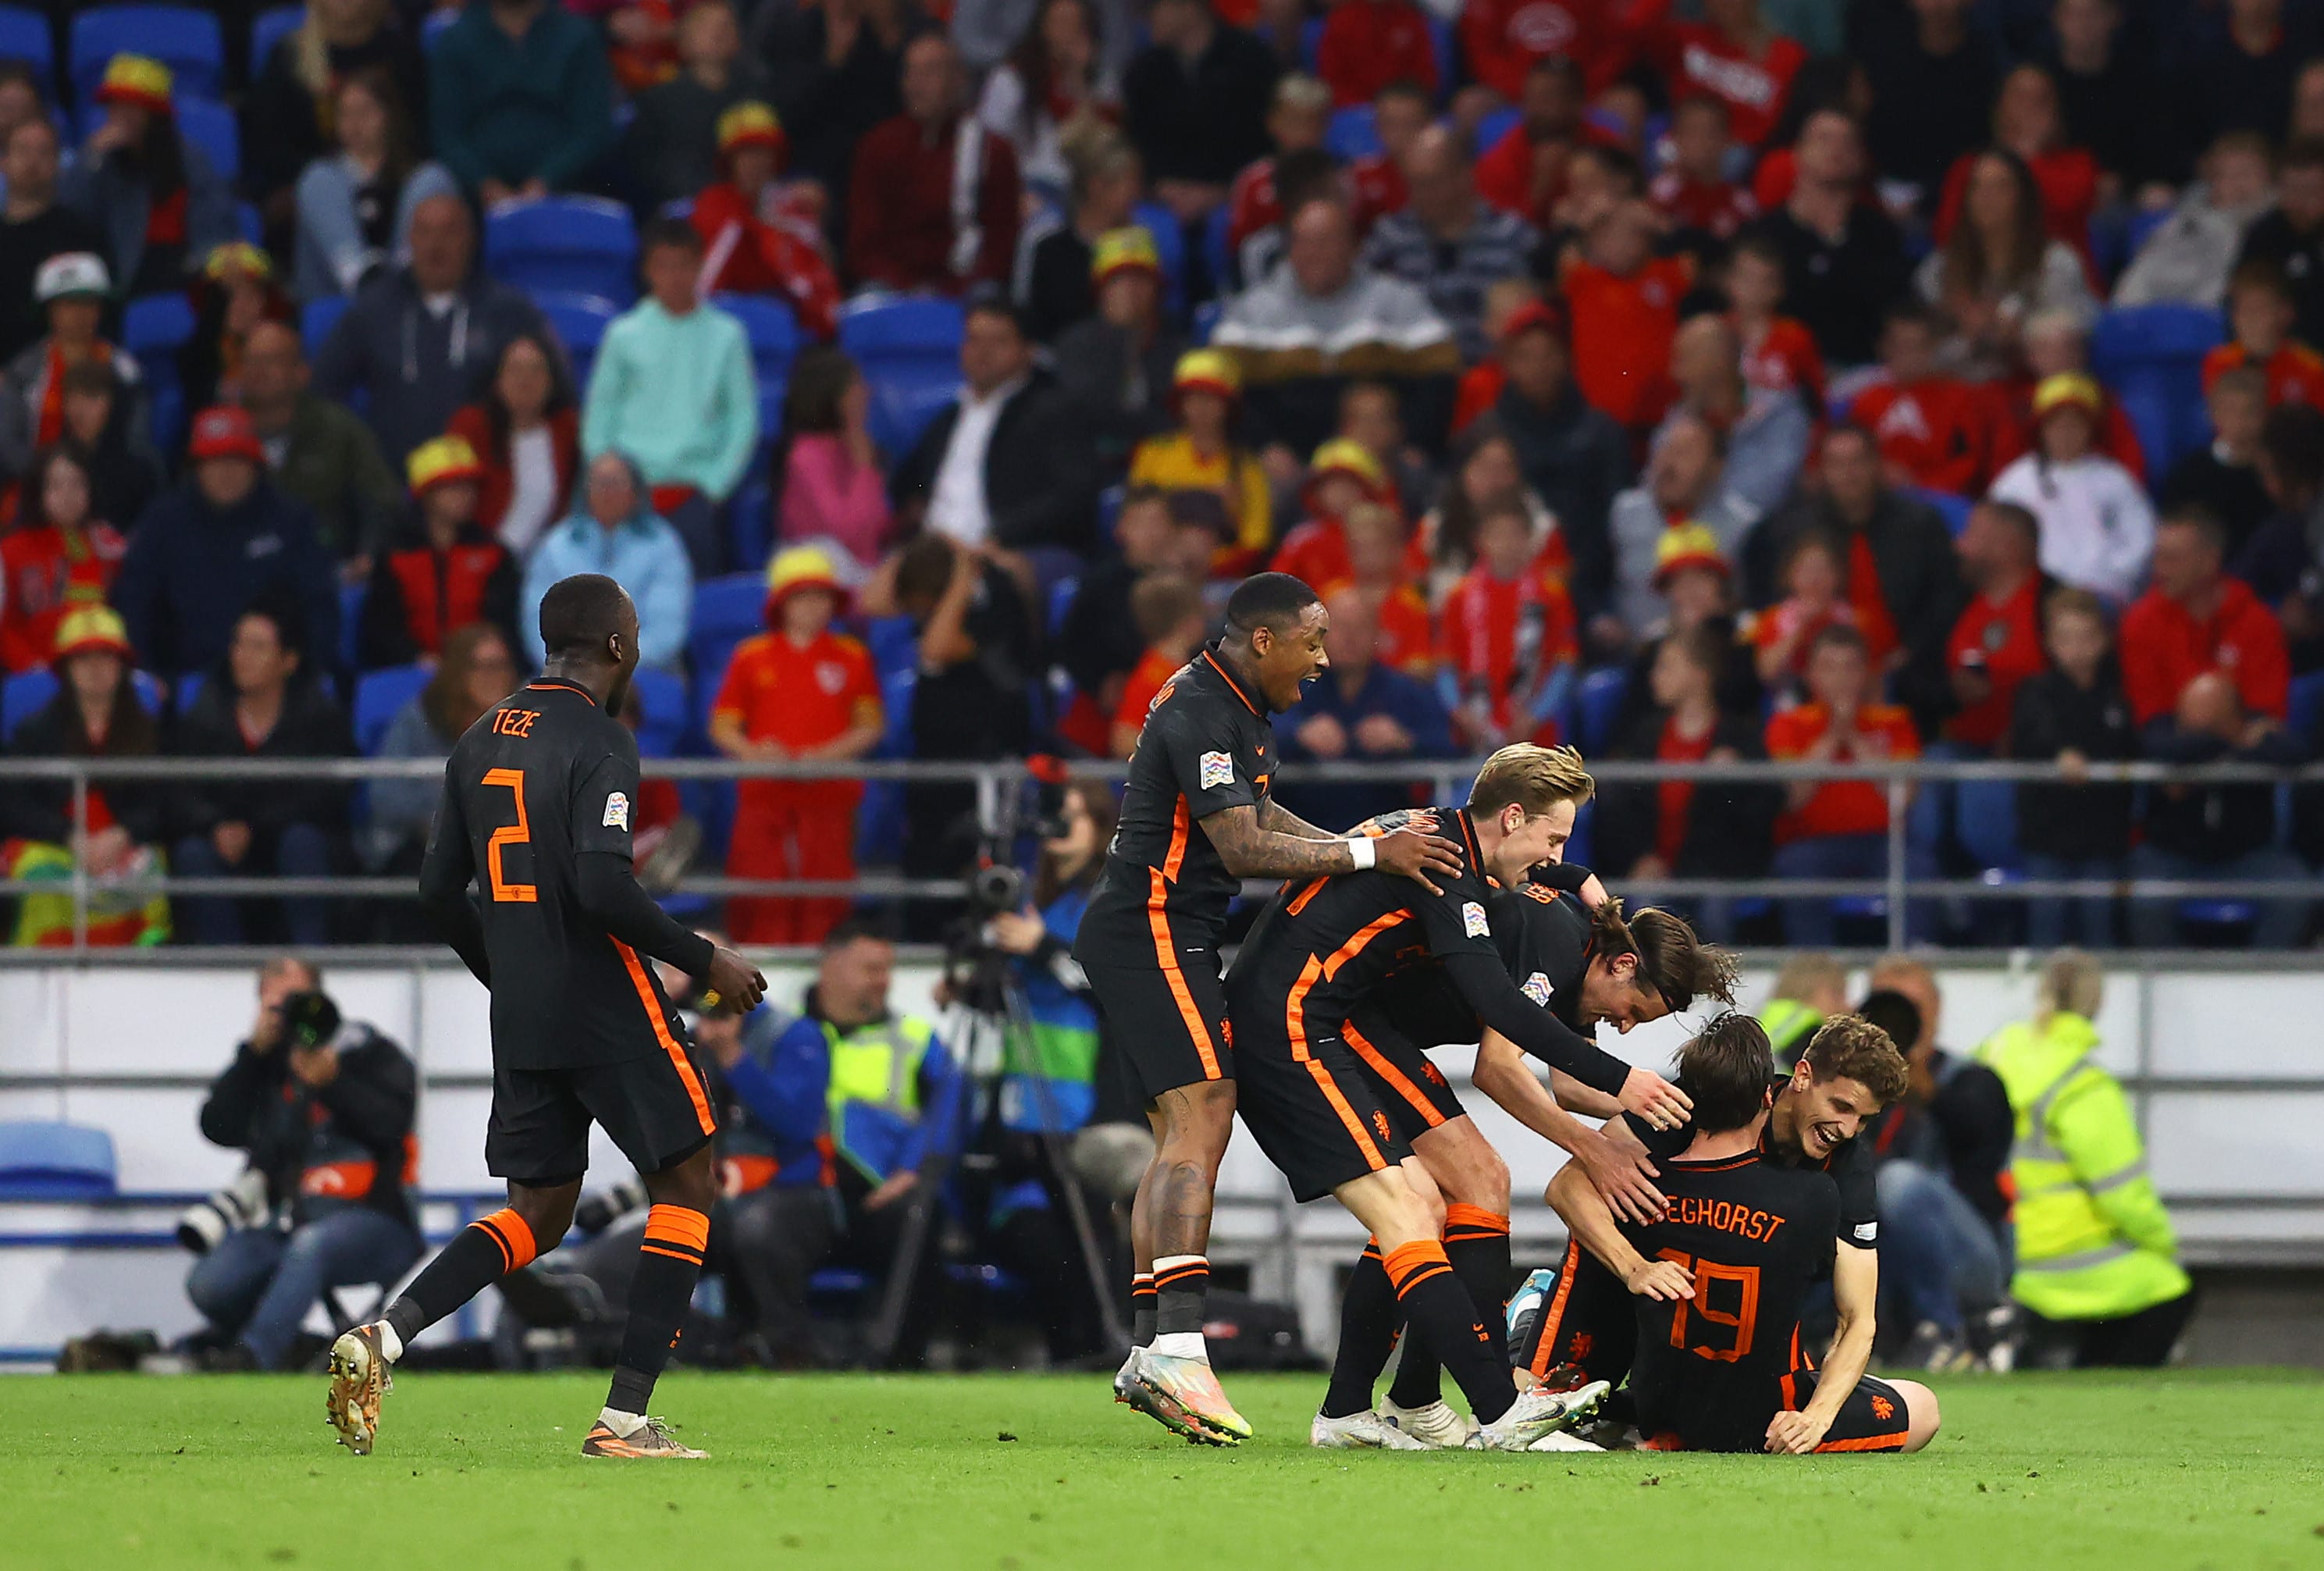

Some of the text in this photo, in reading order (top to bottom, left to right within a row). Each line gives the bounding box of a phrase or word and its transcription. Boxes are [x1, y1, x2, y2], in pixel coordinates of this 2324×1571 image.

[493, 707, 542, 739] TEZE
[481, 768, 537, 902] 2
[1648, 1194, 1786, 1243] EGHORST
[1655, 1247, 1760, 1363] 19
